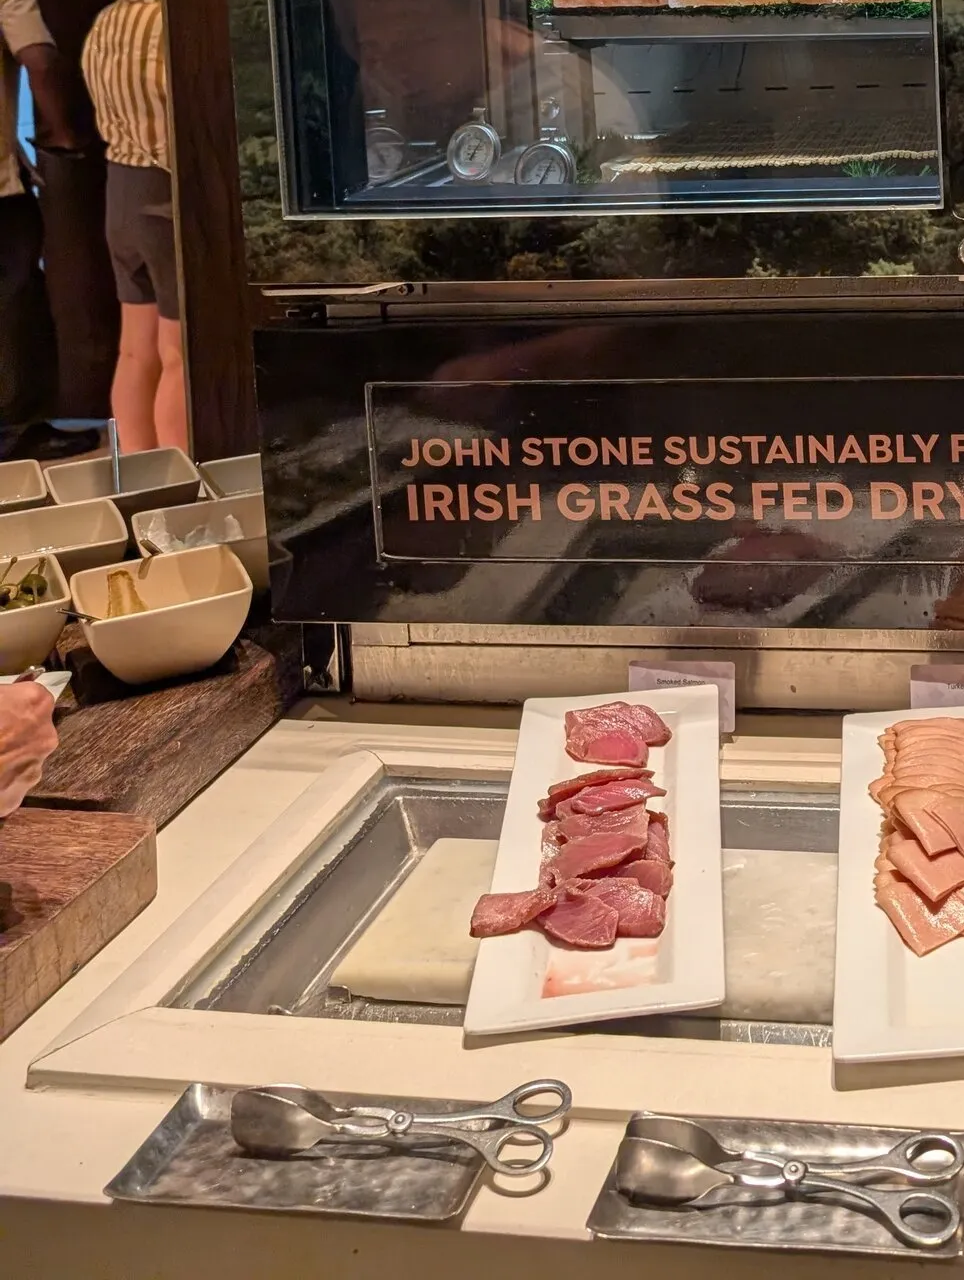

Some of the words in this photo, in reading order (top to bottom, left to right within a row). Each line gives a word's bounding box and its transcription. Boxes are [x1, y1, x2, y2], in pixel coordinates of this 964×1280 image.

[401, 437, 510, 467] JOHN
[521, 436, 653, 466] STONE
[663, 434, 939, 465] SUSTAINABLY
[407, 483, 541, 521] IRISH
[557, 481, 735, 521] GRASS
[752, 481, 855, 521] FED
[656, 678, 681, 686] Smoked
[683, 678, 705, 686] Salmon
